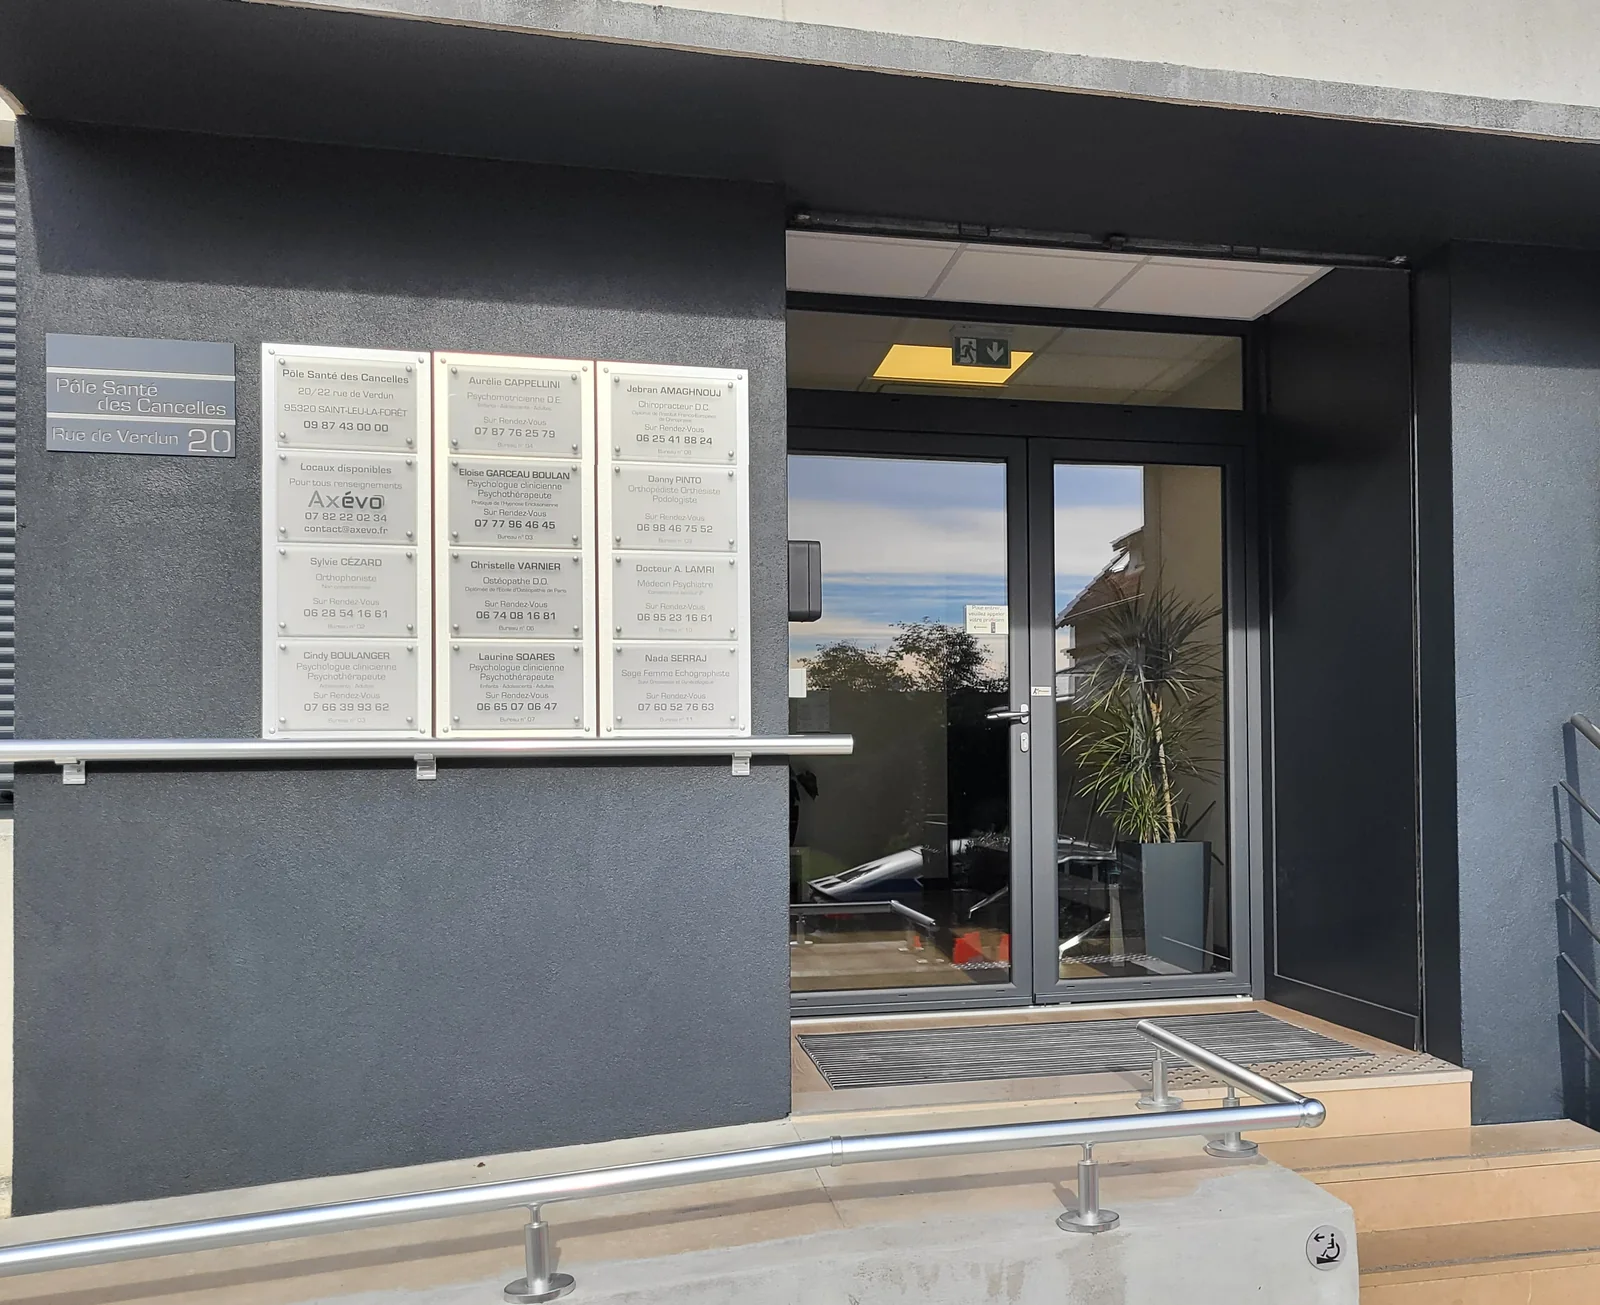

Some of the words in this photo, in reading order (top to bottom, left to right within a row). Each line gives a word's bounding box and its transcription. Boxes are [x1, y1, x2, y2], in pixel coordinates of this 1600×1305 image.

[282, 368, 305, 379] Pôle
[307, 370, 338, 380] Santé
[340, 372, 359, 381] des
[361, 373, 409, 384] Cancelles
[55, 378, 97, 395] Pôle
[102, 380, 158, 397] Santé
[468, 376, 502, 387] Aurélie
[504, 378, 560, 389] CAPPELLINI
[297, 387, 330, 397] 20/22
[333, 389, 348, 398] rue
[350, 390, 361, 398] de
[362, 390, 394, 399] Verdun
[626, 384, 658, 394] Jebran
[660, 387, 722, 397] AMAGHNOUJ
[466, 391, 545, 404] Psychomotricienne
[97, 397, 131, 412] des
[137, 398, 227, 416] Cancelles
[283, 403, 316, 413] 95320
[318, 405, 408, 417] SAINT-LEU-LA-FORÊT
[638, 400, 694, 413] Chiropracteur
[303, 420, 318, 429] 09
[321, 421, 336, 430] 87
[338, 422, 354, 431] 43
[356, 423, 371, 432] 00
[374, 423, 389, 432] 00
[483, 416, 497, 424] Sur
[498, 417, 547, 426] Rendez-Vous
[474, 427, 488, 436] 07
[491, 427, 505, 436] 87
[508, 428, 522, 437] 76
[525, 429, 539, 438] 25
[542, 430, 556, 438] 79
[644, 424, 657, 432] Sur
[659, 424, 705, 434] Rendez-Vous
[52, 427, 86, 442] Rue
[91, 429, 112, 443] de
[116, 430, 179, 446] Verdun
[188, 428, 232, 453] 20
[636, 434, 649, 443] 06
[652, 434, 665, 443] 25
[668, 435, 680, 444] 41
[684, 436, 697, 445] 88
[699, 437, 713, 445] 24
[300, 462, 335, 472] Locaux
[337, 464, 392, 475] disponibles
[486, 469, 530, 479] GARCEAU
[532, 471, 570, 480] BOULAN
[648, 475, 674, 485] Danny
[675, 476, 702, 485] PINTO
[289, 477, 311, 486] Pour
[312, 479, 331, 487] tous
[333, 480, 403, 490] renseignements
[467, 479, 518, 491] Psychologue
[520, 481, 563, 491] clinicienne
[477, 489, 552, 500] Psychothérapeute
[627, 484, 679, 495] Orthopédiste
[308, 490, 385, 509] Axévo
[652, 495, 698, 505] Podologiste
[304, 512, 319, 520] 07
[322, 512, 336, 521] 82
[339, 513, 353, 521] 22
[356, 514, 370, 522] 02
[373, 514, 387, 522] 34
[483, 508, 497, 516] Sur
[499, 509, 547, 518] Rendez-Vous
[304, 525, 388, 535] contact@axevo.fr
[474, 519, 488, 528] 07
[491, 519, 505, 528] 77
[508, 520, 522, 529] 96
[525, 520, 539, 529] 46
[541, 521, 556, 530] 45
[636, 523, 650, 532] 06
[652, 524, 666, 532] 98
[668, 524, 682, 533] 46
[684, 525, 698, 533] 75
[700, 525, 713, 534] 52
[310, 557, 338, 568] Sylvie
[340, 556, 382, 567] CÉZARD
[470, 560, 515, 570] Christelle
[517, 562, 561, 571] VARNIER
[635, 564, 672, 573] Docteur
[685, 565, 715, 574] LAMRI
[315, 573, 377, 583] Orthophoniste
[482, 576, 531, 587] Ostéopathe
[637, 579, 671, 588] Médecin
[672, 580, 714, 590] Psychiatre
[484, 600, 499, 608] Sur
[500, 601, 548, 609] Rendez-Vous
[303, 609, 318, 617] 06
[321, 609, 336, 618] 28
[339, 609, 354, 618] 54
[357, 610, 372, 618] 16
[374, 610, 388, 619] 61
[475, 611, 490, 619] 06
[493, 611, 507, 620] 74
[509, 611, 523, 620] 08
[526, 611, 540, 620] 16
[543, 612, 556, 620] 81
[637, 613, 651, 621] 06
[652, 613, 666, 622] 95
[669, 614, 682, 622] 23
[685, 614, 698, 622] 16
[700, 614, 713, 622] 61
[303, 651, 329, 662] Cindy
[330, 651, 390, 660] BOULANGER
[478, 653, 514, 661] Laurine
[515, 653, 556, 661] SOARES
[644, 654, 669, 663] Nada
[670, 654, 707, 663] SERRAJ
[296, 662, 350, 672] Psychologue
[352, 663, 397, 671] clinicienne
[469, 663, 521, 673] Psychologue
[522, 663, 565, 672] clinicienne
[307, 672, 386, 682] Psychothérapeute
[479, 673, 555, 682] Psychothérapeute
[621, 669, 642, 679] Sage
[643, 669, 674, 677] Femme
[485, 691, 500, 699] Sur
[501, 691, 549, 699] Rendez-Vous
[303, 703, 318, 712] 07
[321, 703, 336, 712] 66
[339, 703, 354, 712] 39
[357, 703, 372, 712] 93
[375, 703, 390, 712] 62
[476, 702, 491, 711] 06
[493, 702, 508, 711] 65
[510, 702, 524, 711] 07
[527, 702, 541, 711] 06
[543, 702, 558, 711] 47
[637, 703, 651, 711] 07
[654, 703, 668, 711] 60
[669, 703, 683, 711] 52
[685, 703, 699, 711] 76
[701, 703, 715, 711] 63
